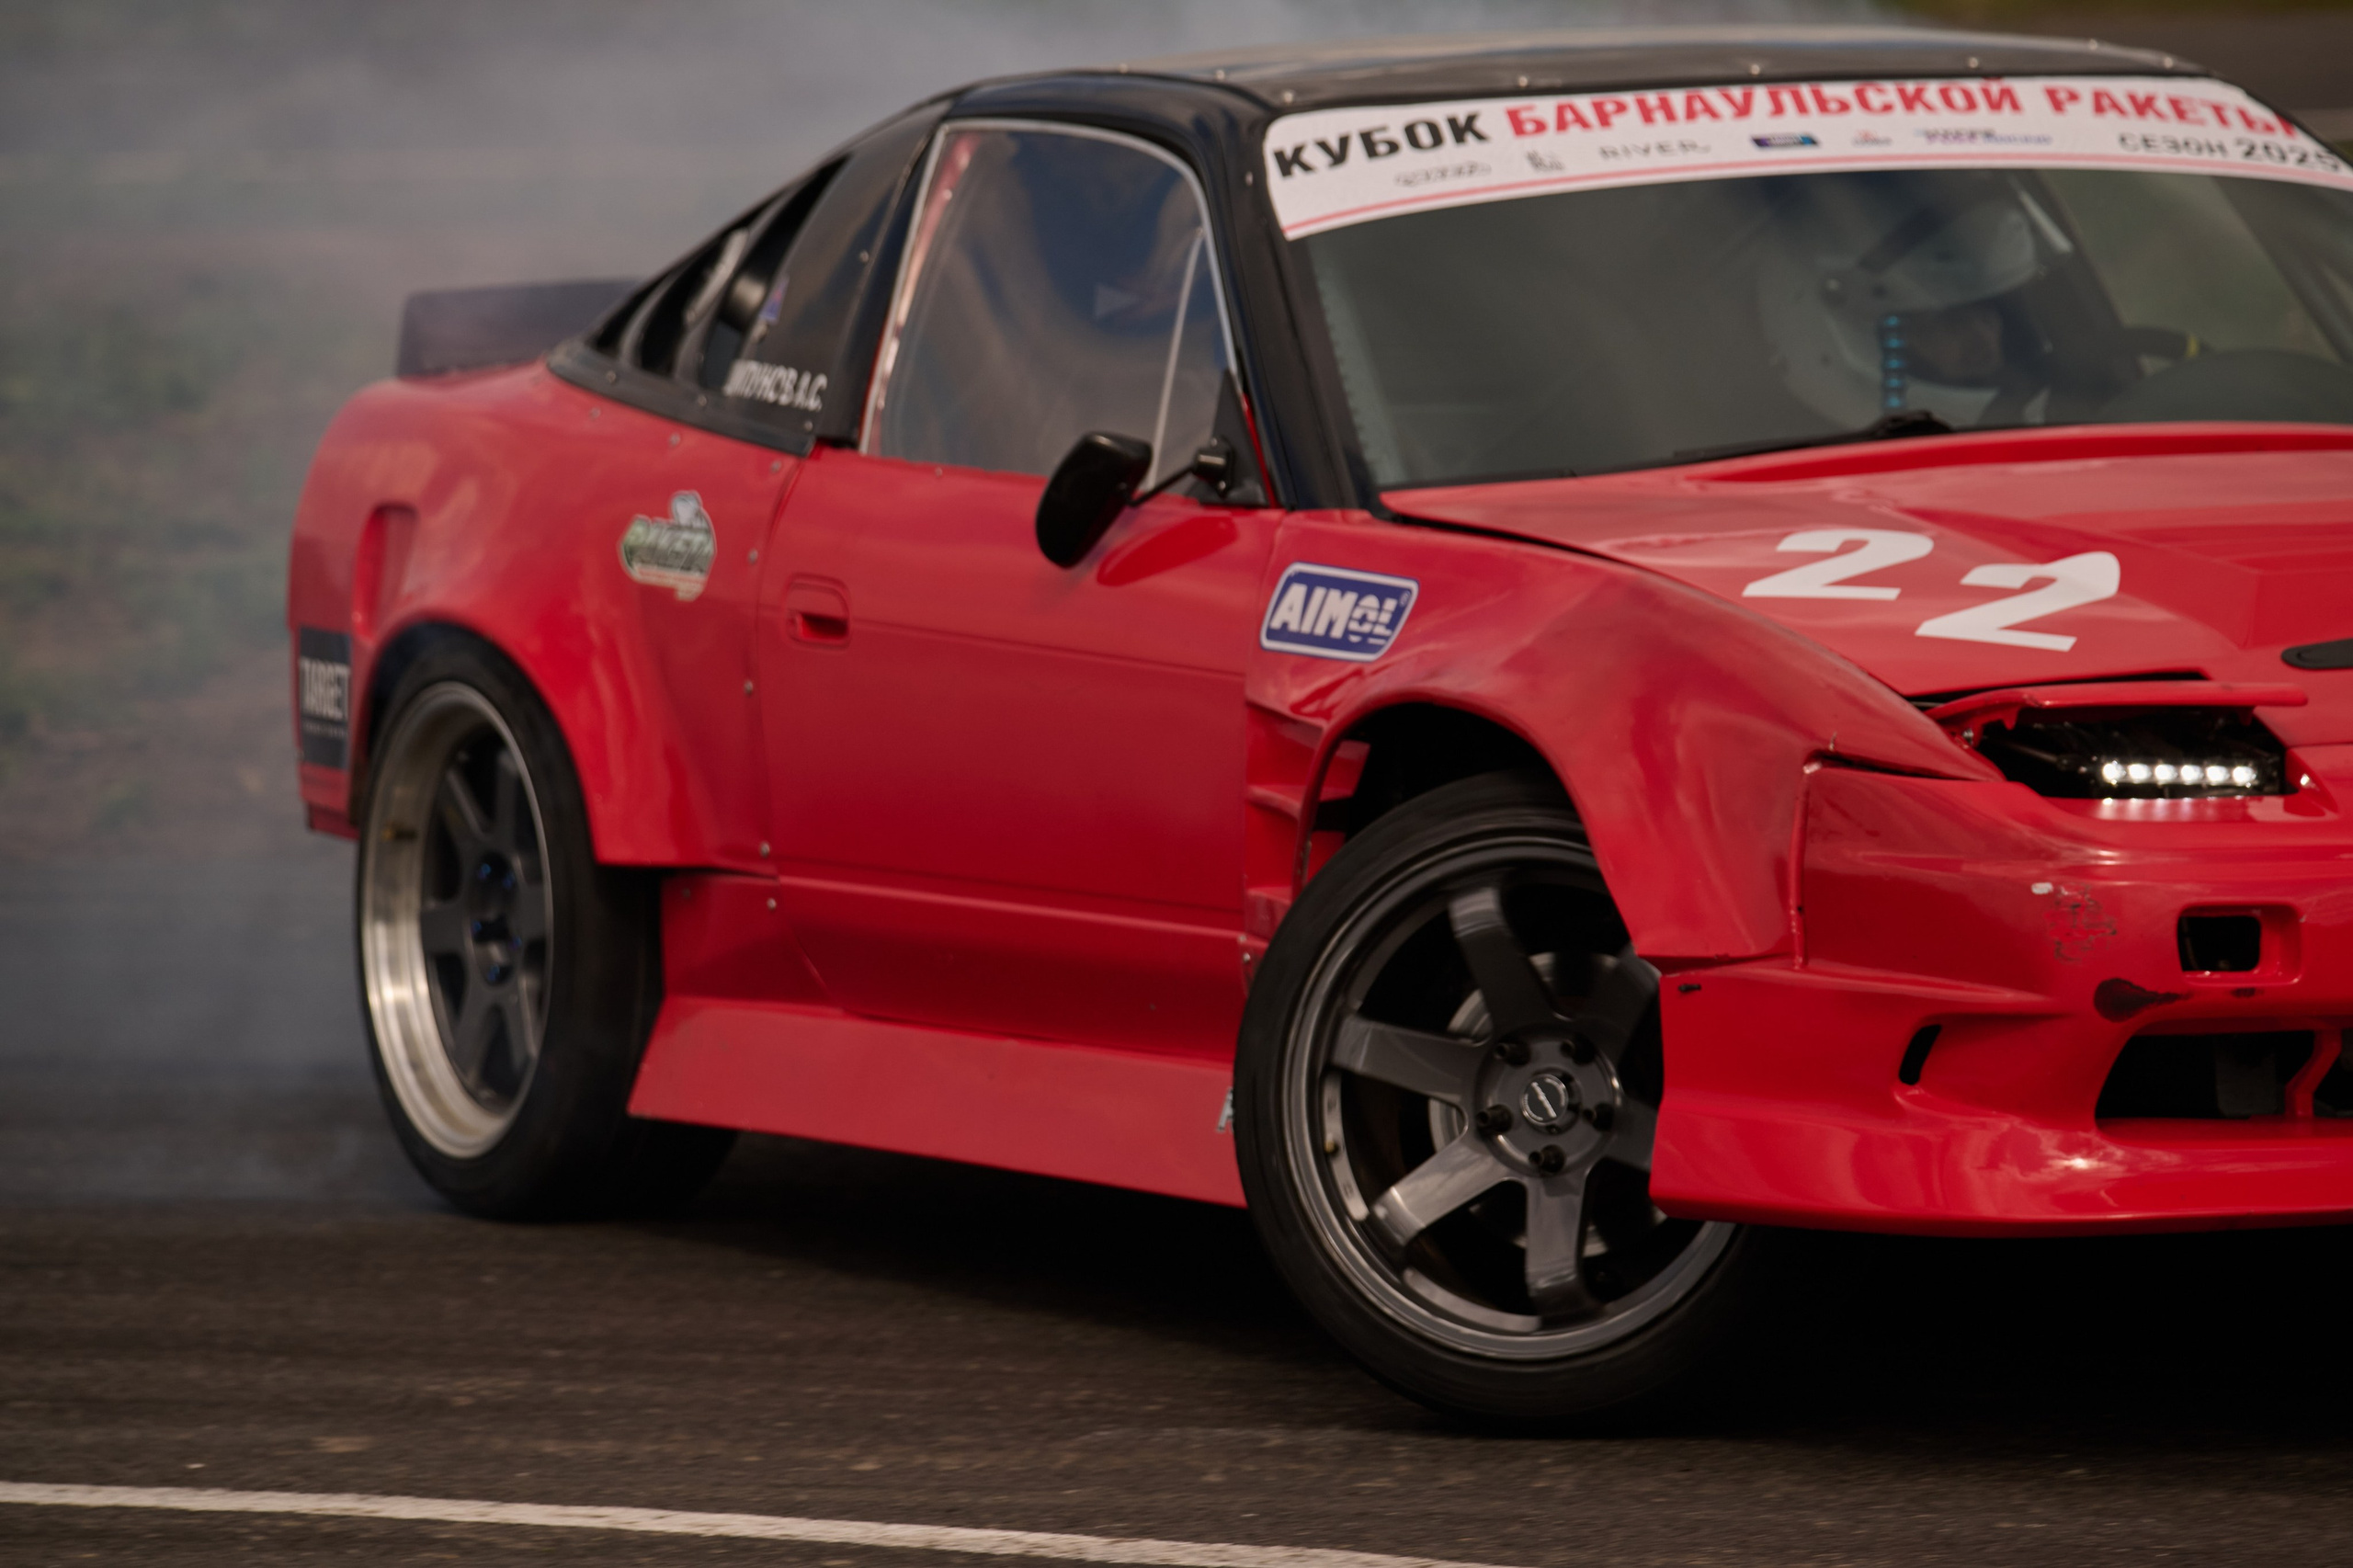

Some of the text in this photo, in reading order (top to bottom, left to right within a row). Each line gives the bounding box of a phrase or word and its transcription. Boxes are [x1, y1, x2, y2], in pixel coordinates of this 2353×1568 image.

[1272, 111, 1490, 178] КУБОК
[1505, 76, 2026, 139] БАРНАУЛЬСКОЙ
[2118, 131, 2341, 173] СЕЗОН 2025
[1269, 583, 1398, 644] AIMOL
[1742, 528, 2120, 652] 22
